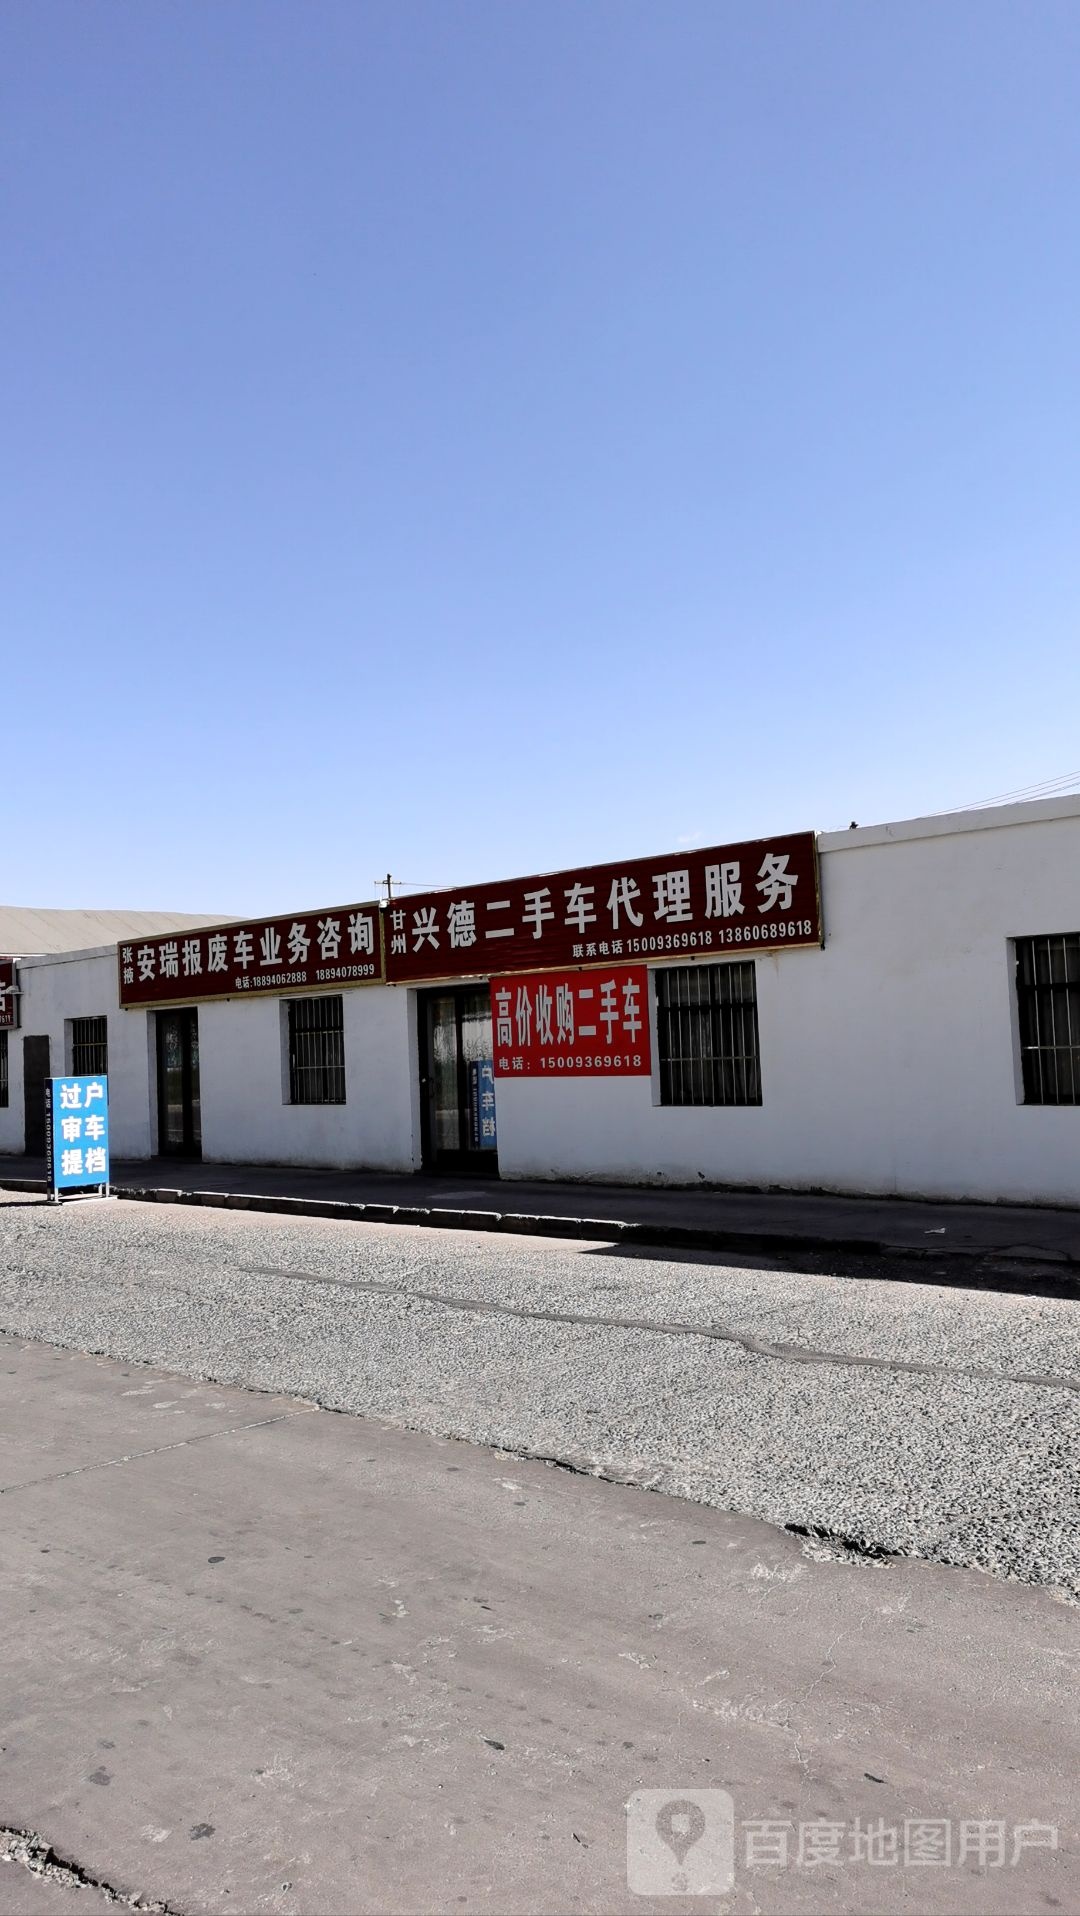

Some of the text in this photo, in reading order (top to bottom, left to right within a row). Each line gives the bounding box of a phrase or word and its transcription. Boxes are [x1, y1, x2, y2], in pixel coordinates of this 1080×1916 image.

[412, 853, 799, 953] 兴德二手车代理服务
[137, 912, 374, 982] 安瑞报废车业务咨询
[390, 909, 407, 954] 甘州
[718, 920, 812, 944] 13860689618
[122, 946, 134, 984] 张掖
[316, 963, 375, 980] 18894078999
[495, 977, 643, 1047] 高价收购二手车
[60, 1082, 103, 1109] 过户
[61, 1115, 105, 1142] 审车
[61, 1147, 106, 1176] 提档
